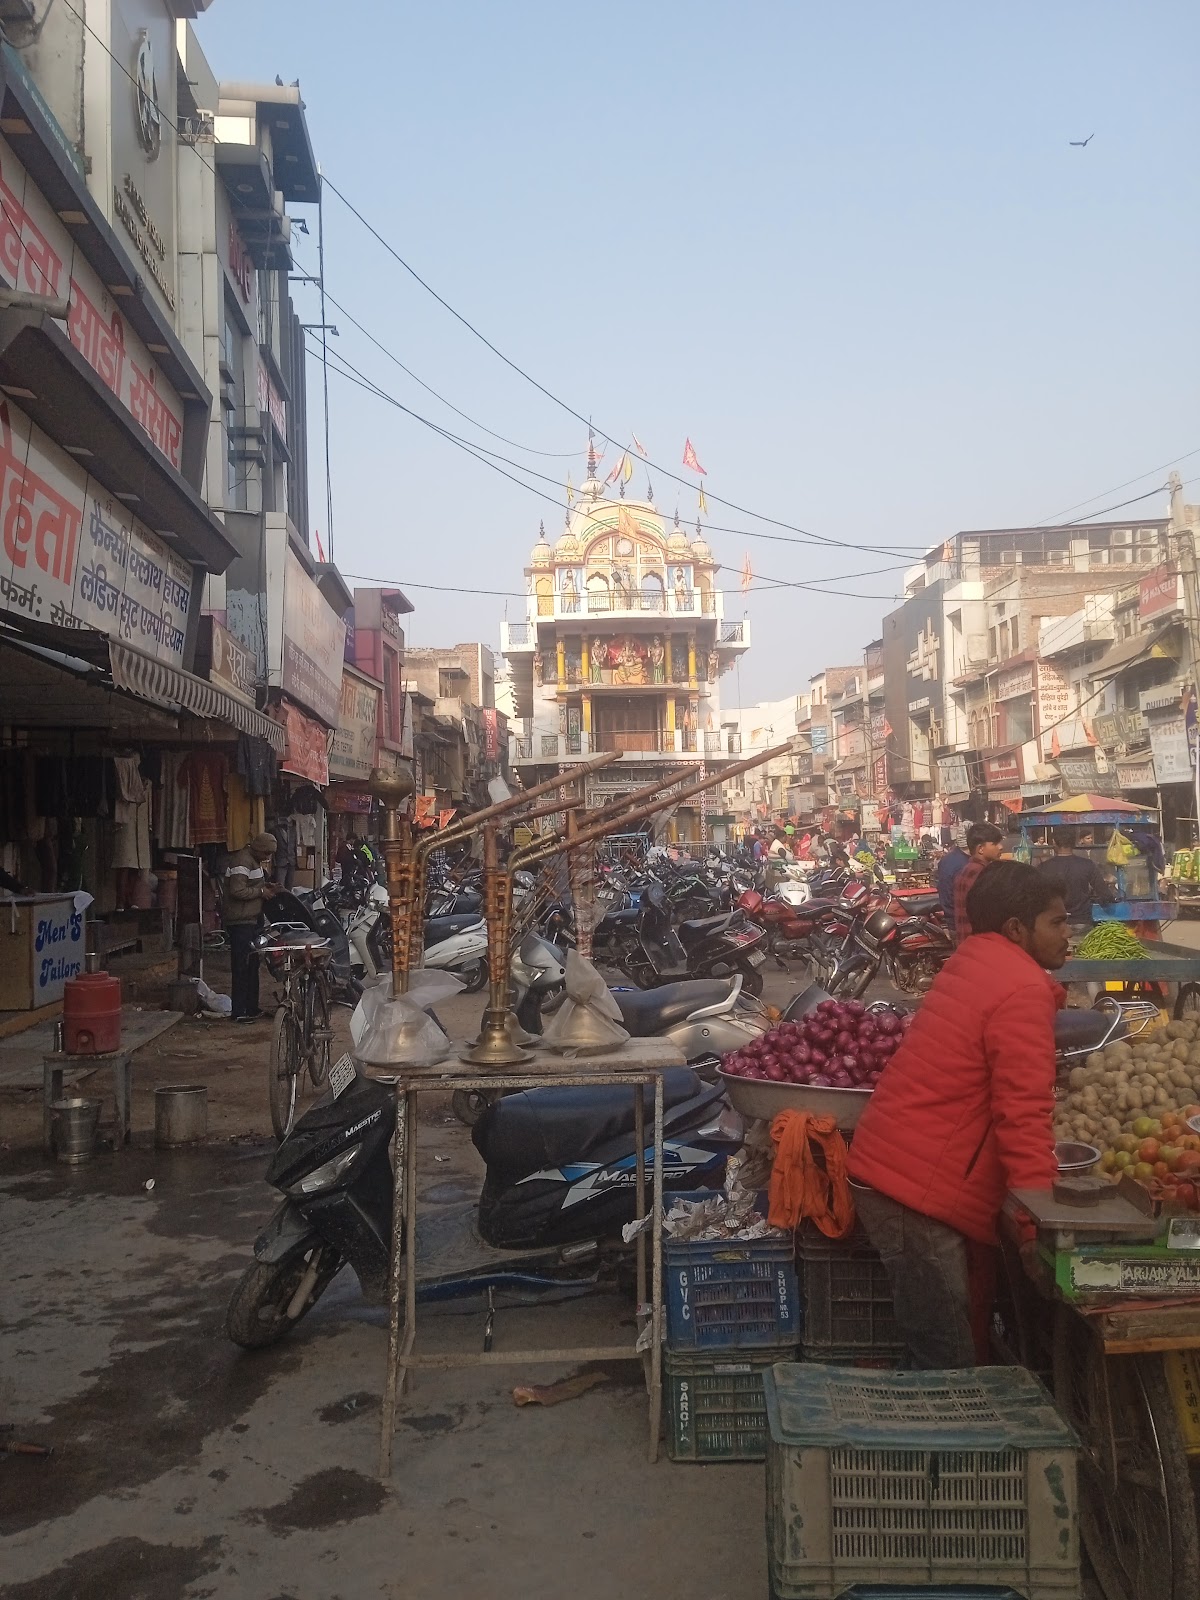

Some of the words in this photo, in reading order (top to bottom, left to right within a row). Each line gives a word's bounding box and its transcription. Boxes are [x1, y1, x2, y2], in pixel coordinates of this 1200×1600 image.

[40, 958, 80, 987] Tailors
[598, 1170, 686, 1182] MAESRO
[777, 1270, 786, 1304] SHOP
[780, 1311, 789, 1319] 53
